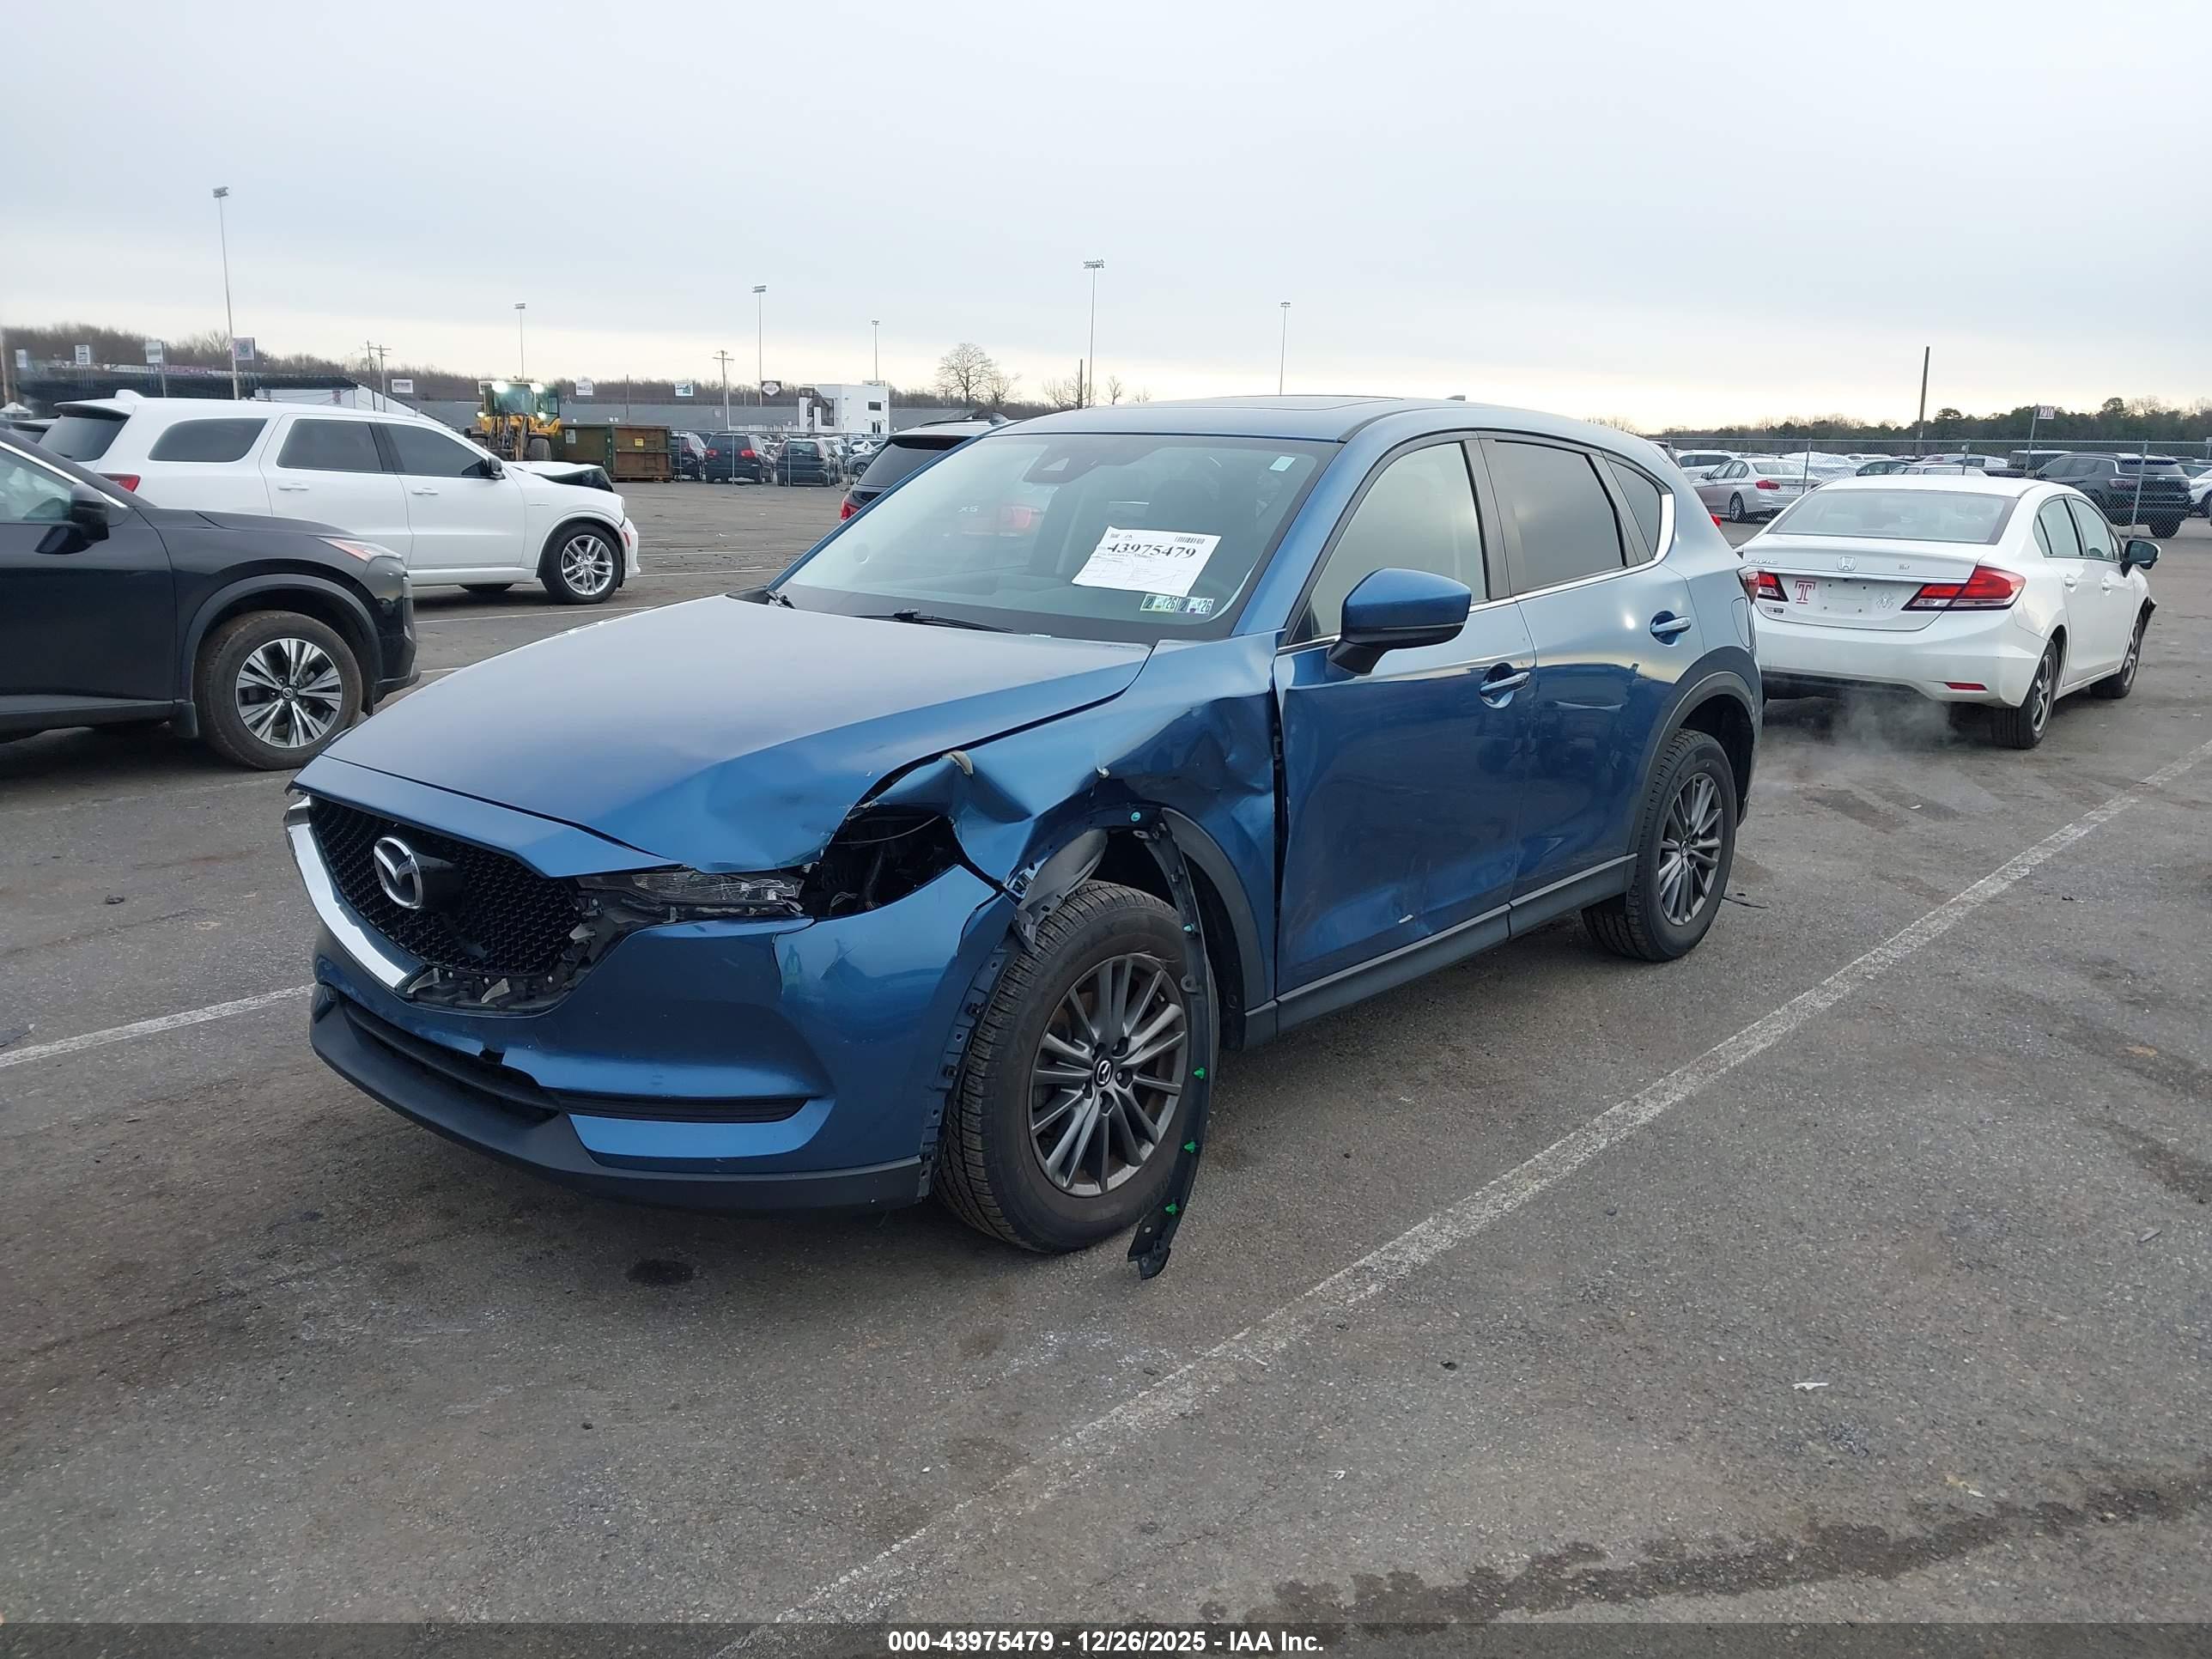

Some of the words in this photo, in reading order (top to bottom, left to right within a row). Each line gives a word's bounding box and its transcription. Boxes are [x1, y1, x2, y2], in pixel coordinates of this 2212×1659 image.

[1107, 543, 1196, 558] 43975479
[1795, 580, 1817, 605] T
[1146, 598, 1155, 609] 2
[1200, 599, 1212, 612] 26
